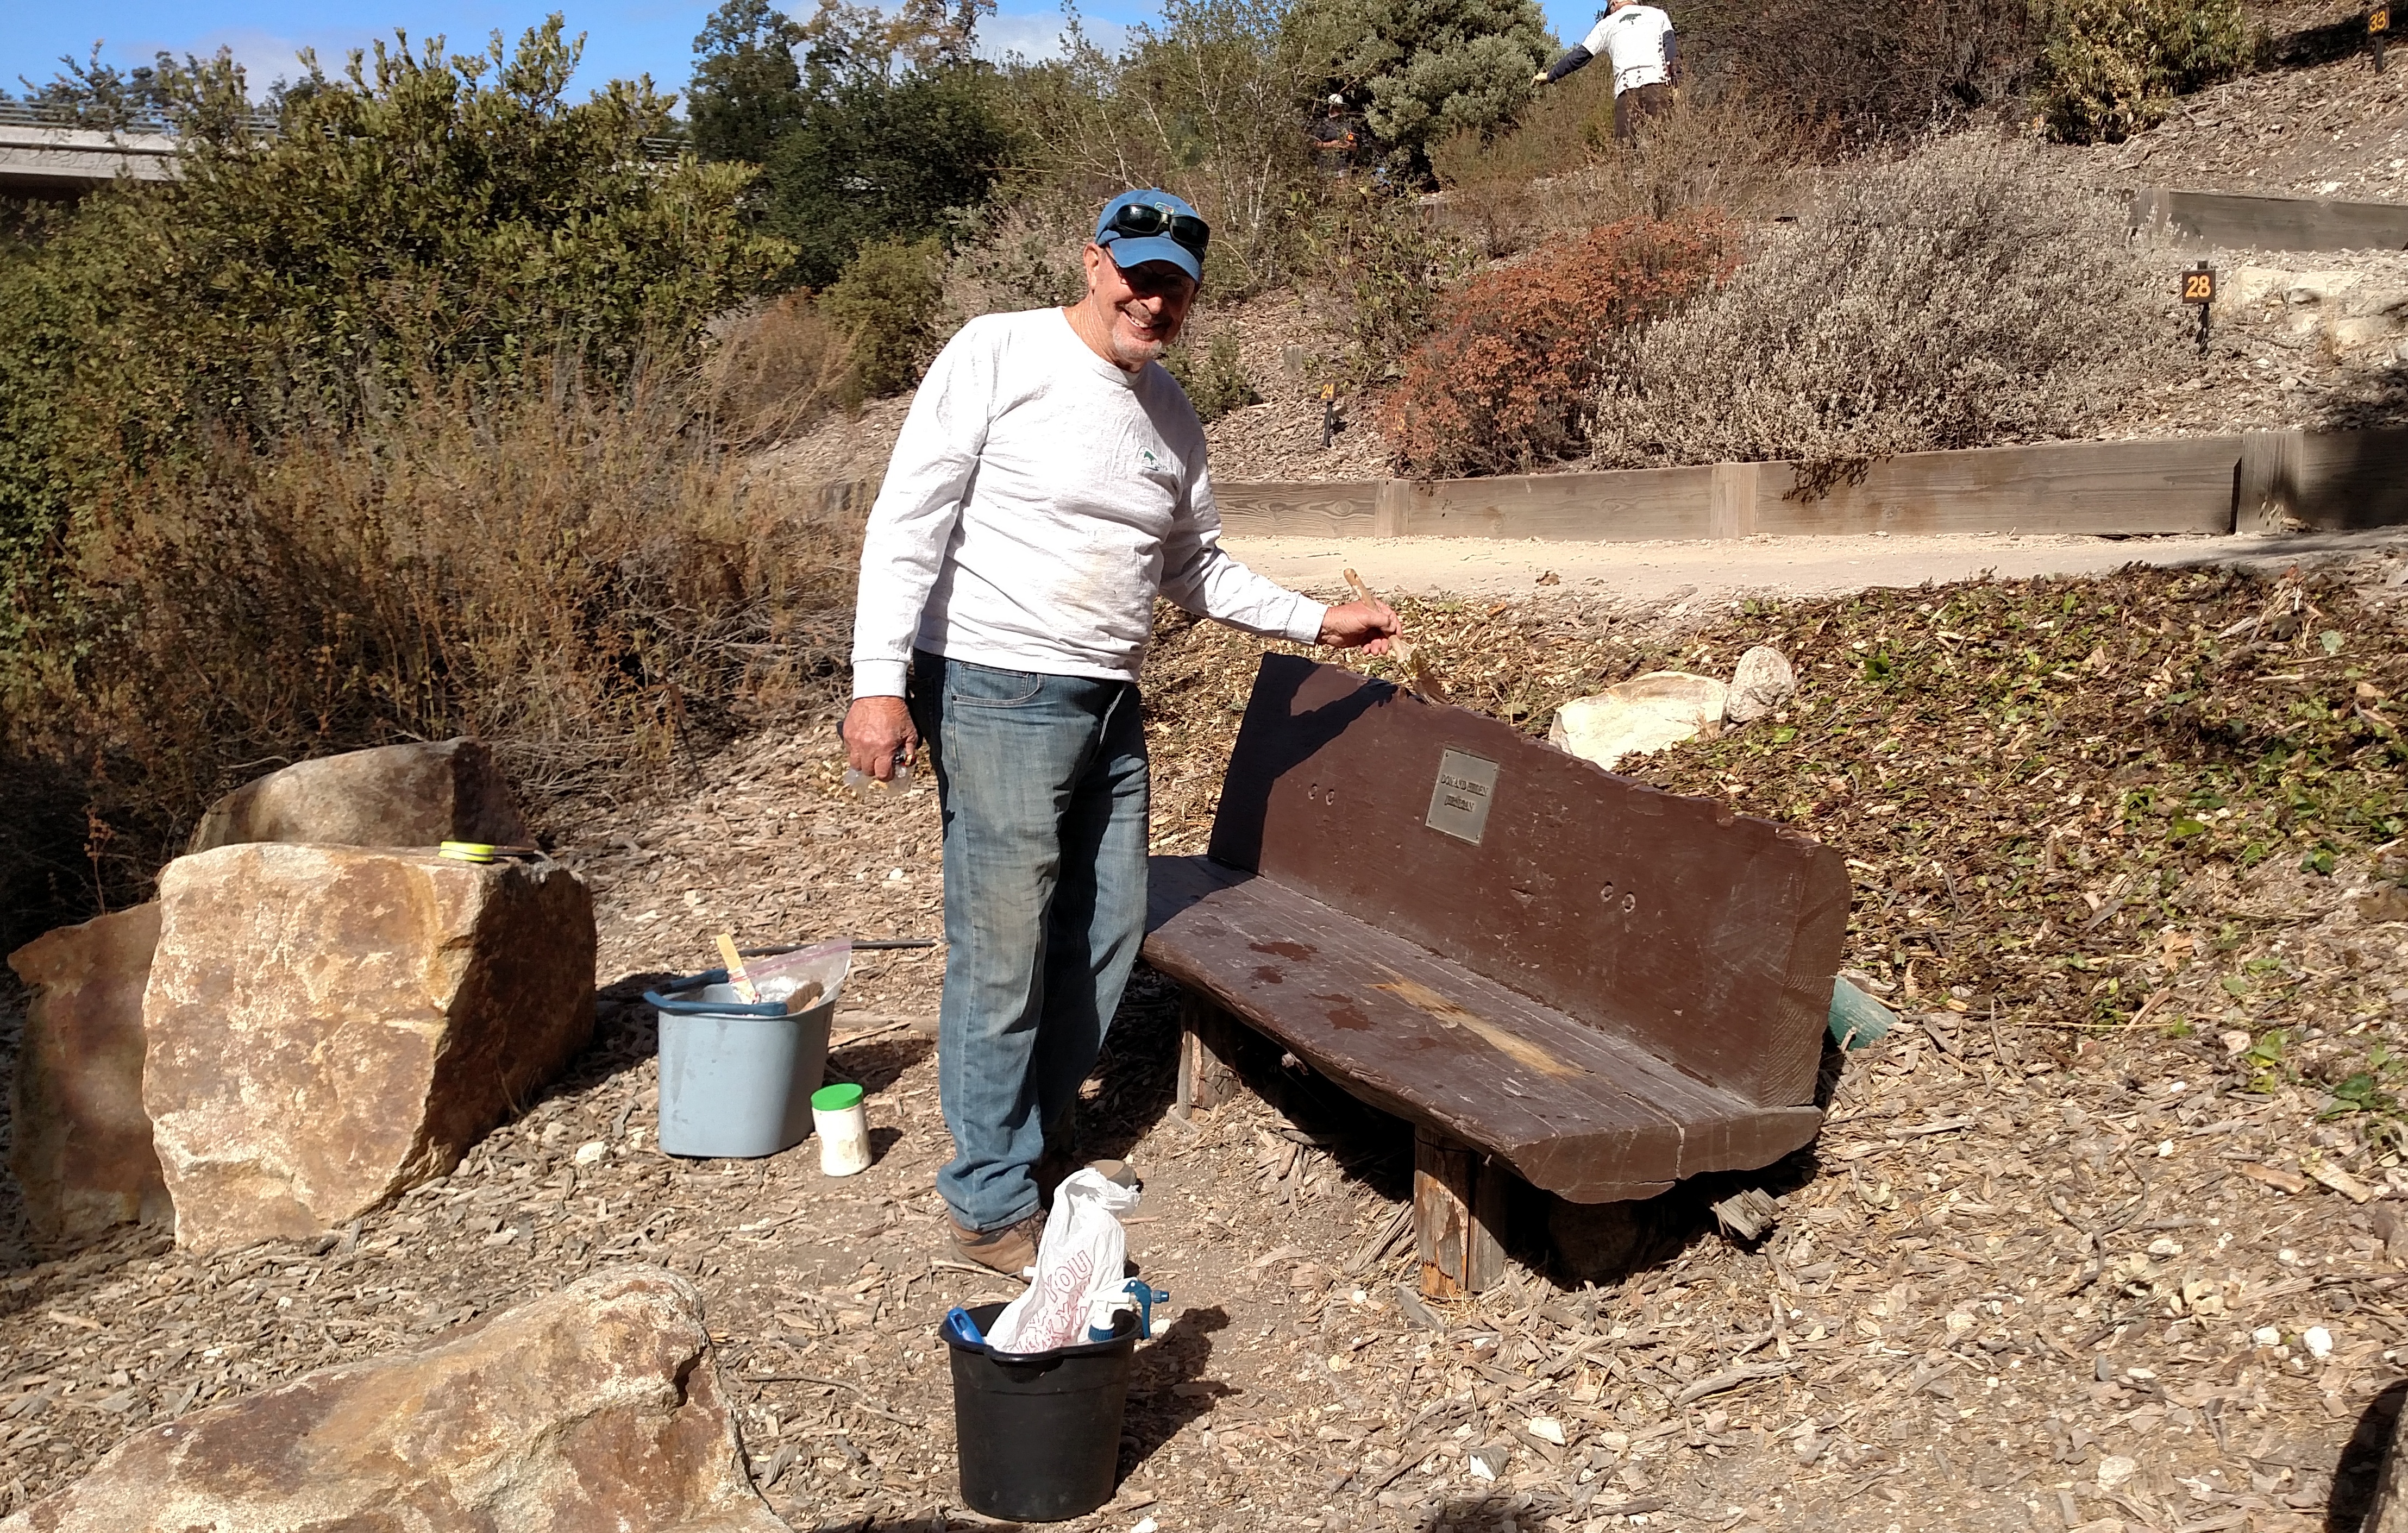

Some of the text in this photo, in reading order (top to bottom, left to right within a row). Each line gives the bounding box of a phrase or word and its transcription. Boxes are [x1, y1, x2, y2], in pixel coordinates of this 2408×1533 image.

[2369, 11, 2386, 32] 33
[2185, 275, 2211, 298] 28
[1320, 383, 1334, 399] 24
